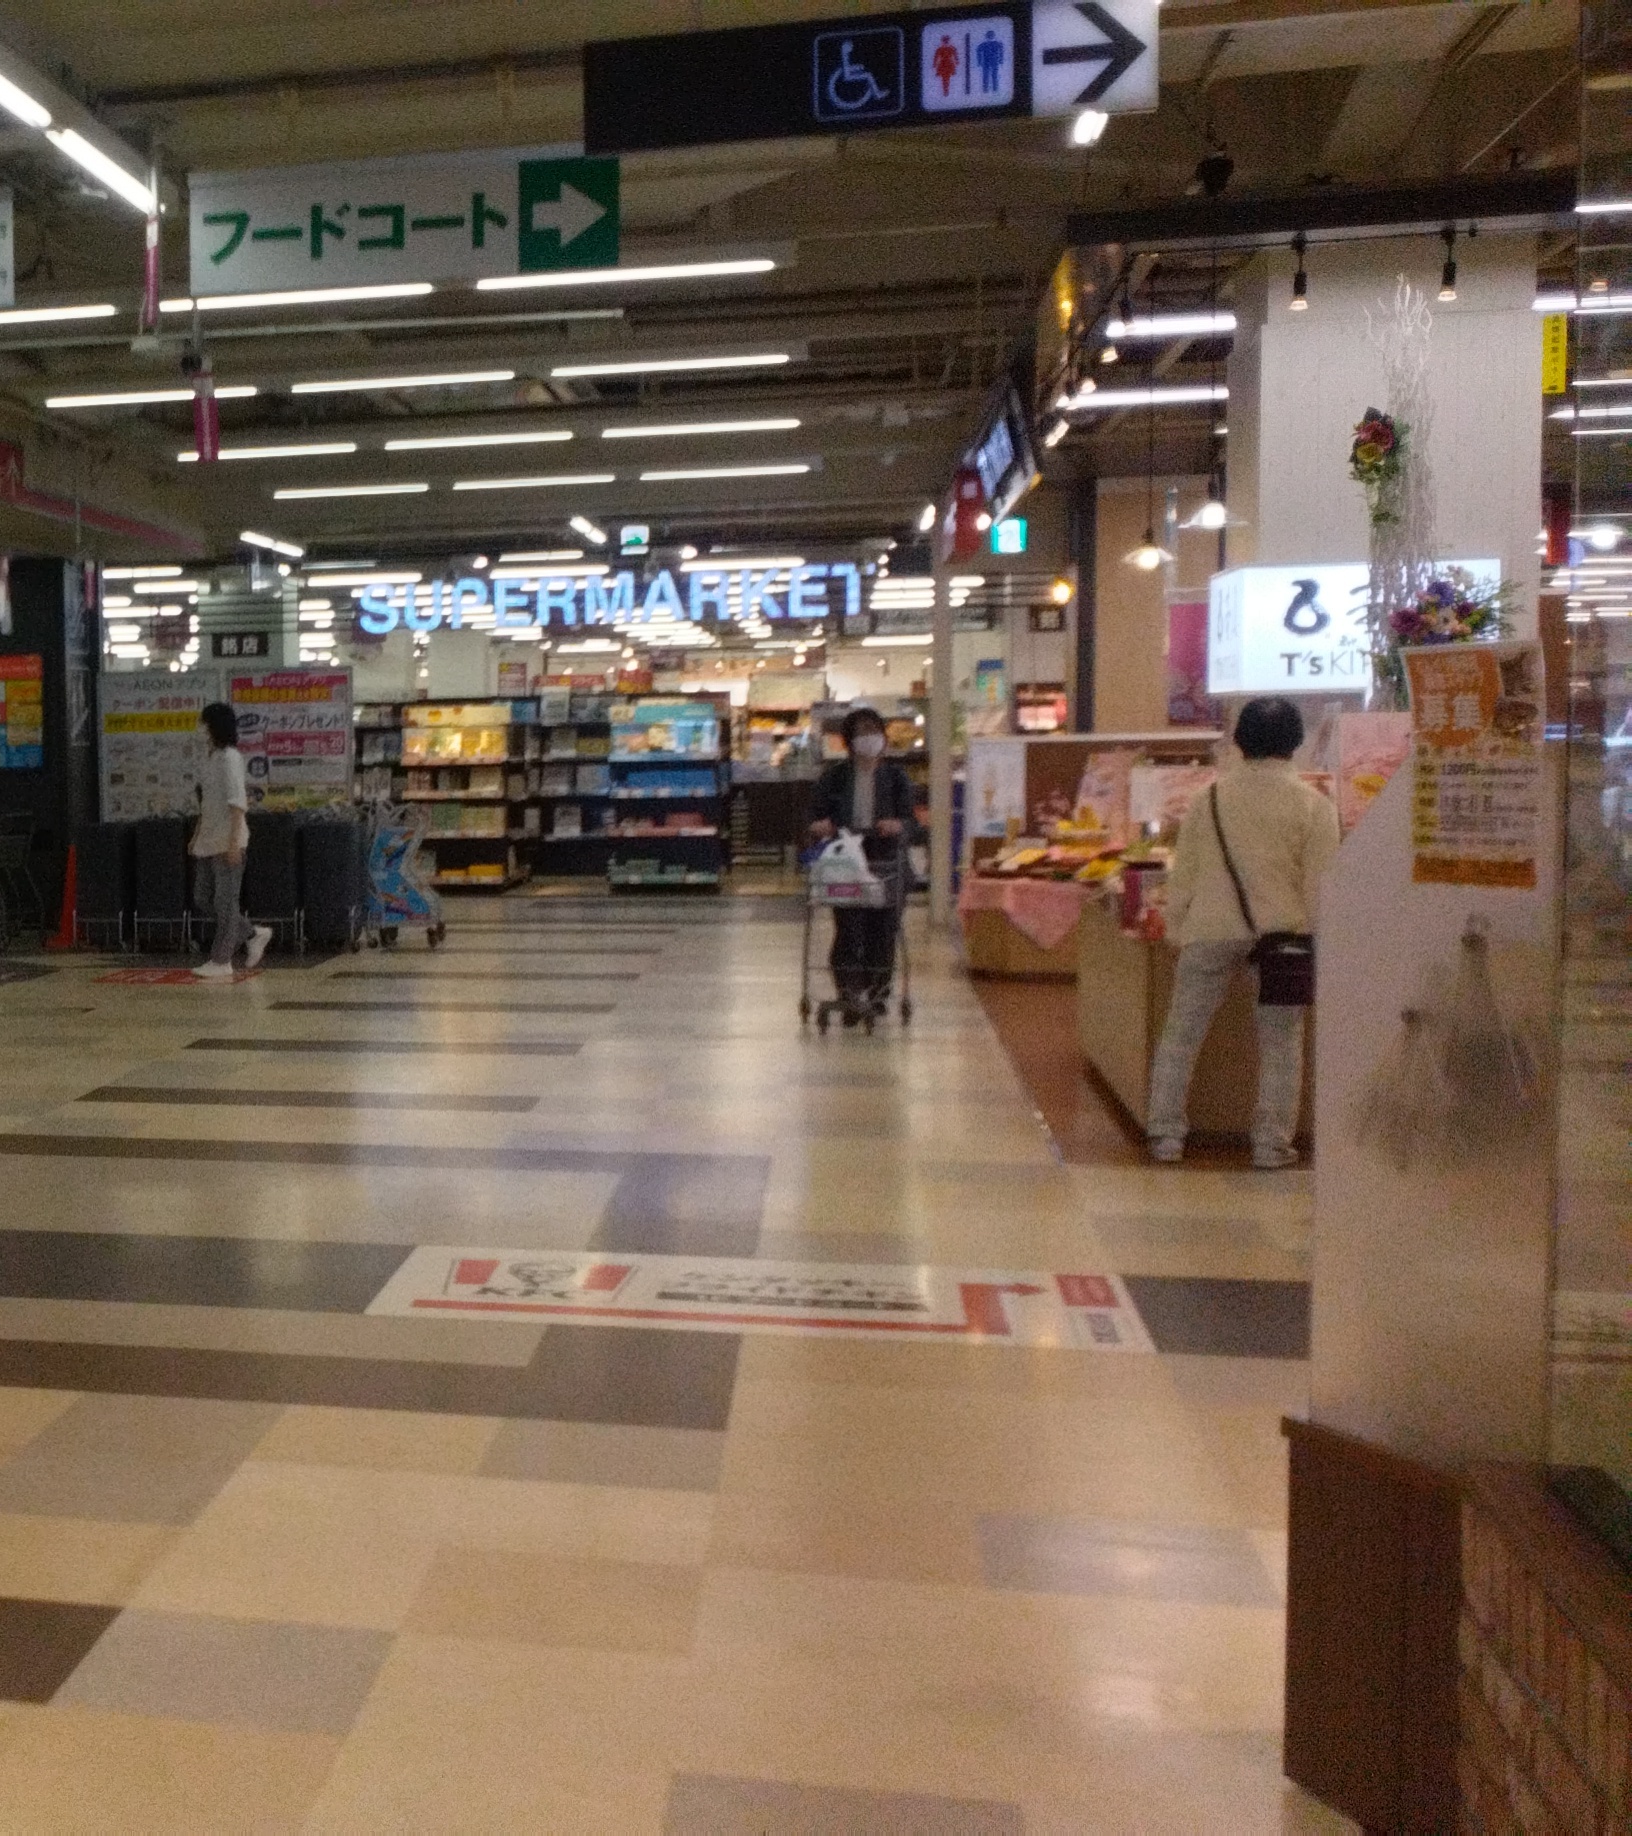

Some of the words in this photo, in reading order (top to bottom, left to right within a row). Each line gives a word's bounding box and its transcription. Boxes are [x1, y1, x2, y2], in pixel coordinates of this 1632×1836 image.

[202, 191, 509, 266] フードコート
[358, 562, 876, 634] SUPERMARKET
